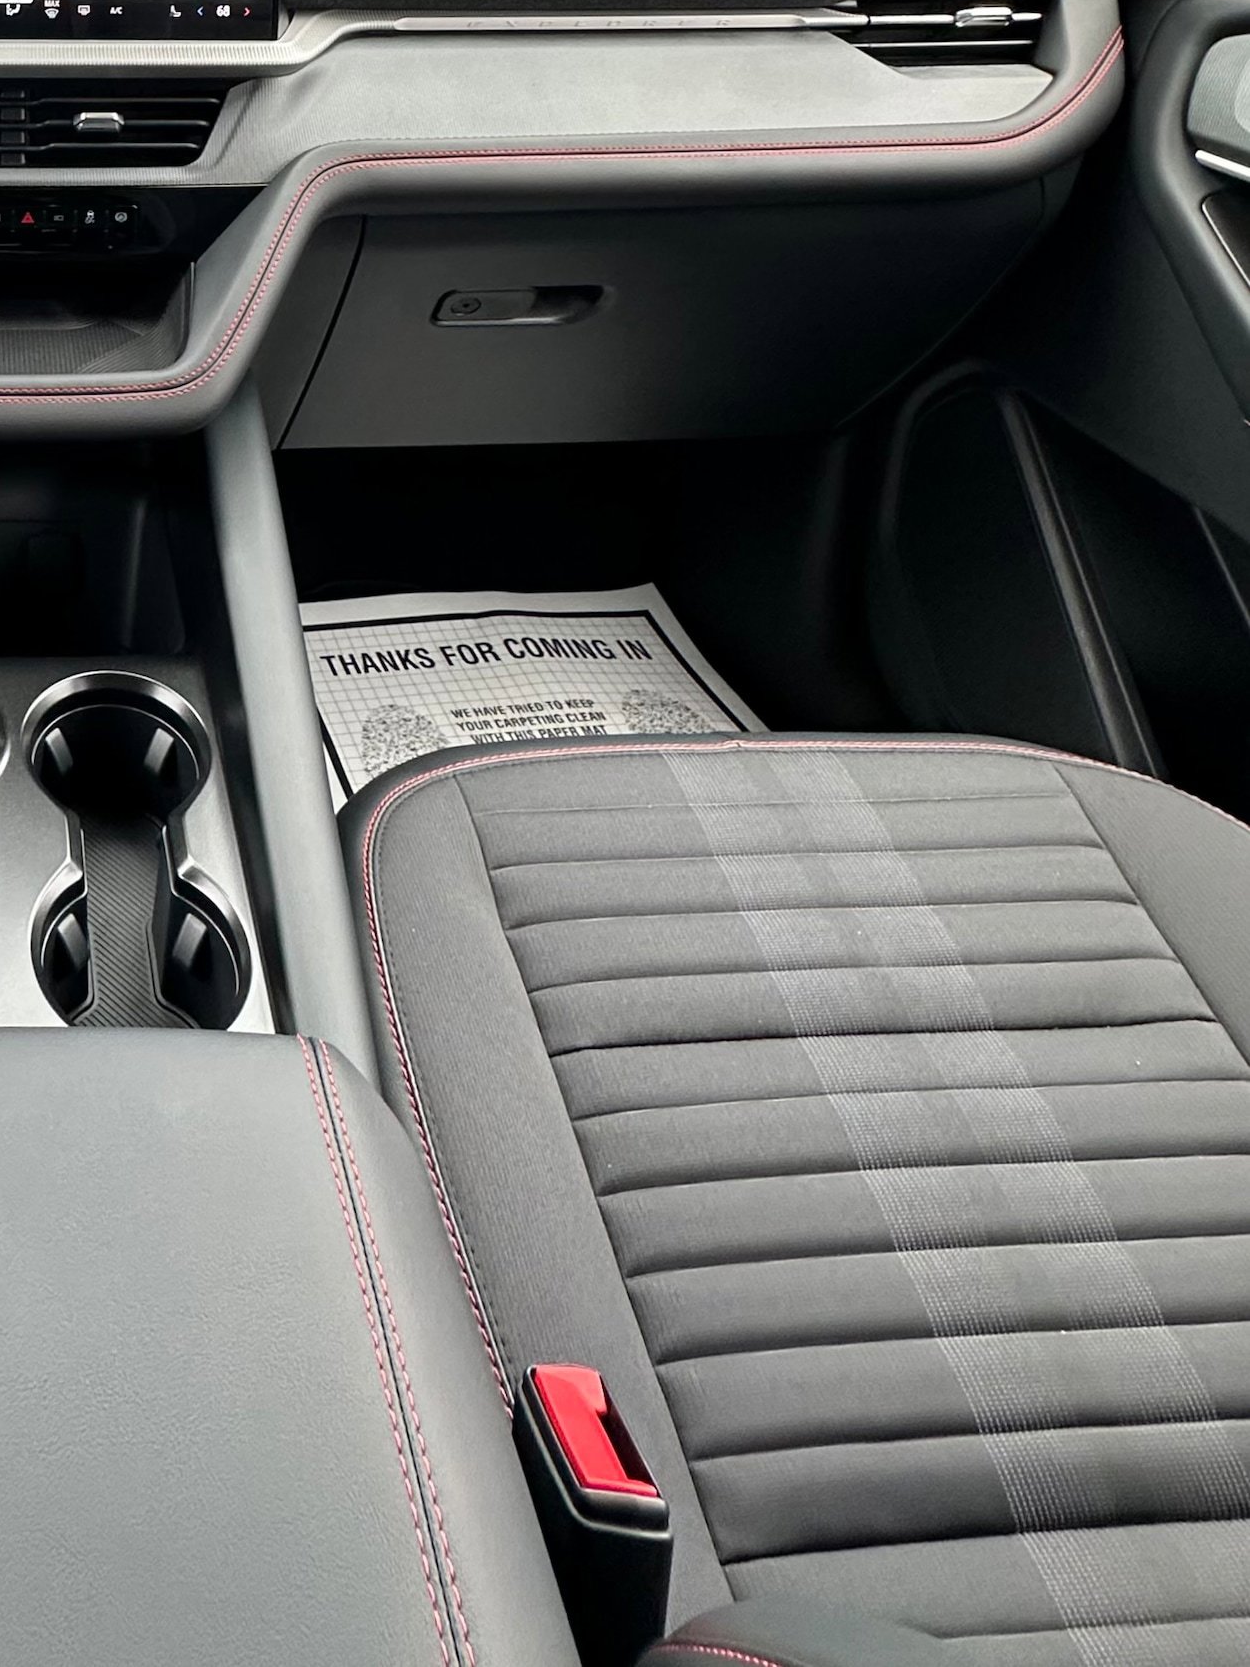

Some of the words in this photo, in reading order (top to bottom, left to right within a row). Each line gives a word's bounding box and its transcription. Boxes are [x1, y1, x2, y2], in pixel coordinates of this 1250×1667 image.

[44, 0, 60, 8] MAX
[110, 6, 123, 15] A/C
[216, 4, 230, 17] 68
[320, 647, 436, 677] THANKS
[439, 641, 501, 666] FOR
[503, 637, 617, 660] COMING
[619, 639, 653, 661] IN
[451, 708, 472, 719] WE
[473, 705, 507, 717] HAVE
[506, 702, 544, 714] TRIED
[545, 700, 563, 711] TO
[564, 699, 595, 709] KEEP
[456, 719, 493, 732] YOUR
[494, 714, 565, 730] CARPETING
[565, 711, 607, 723] CLEAN
[470, 733, 507, 745] WITH
[508, 729, 537, 742] THIS
[538, 728, 579, 740] PAPER
[580, 725, 608, 736] MAT
